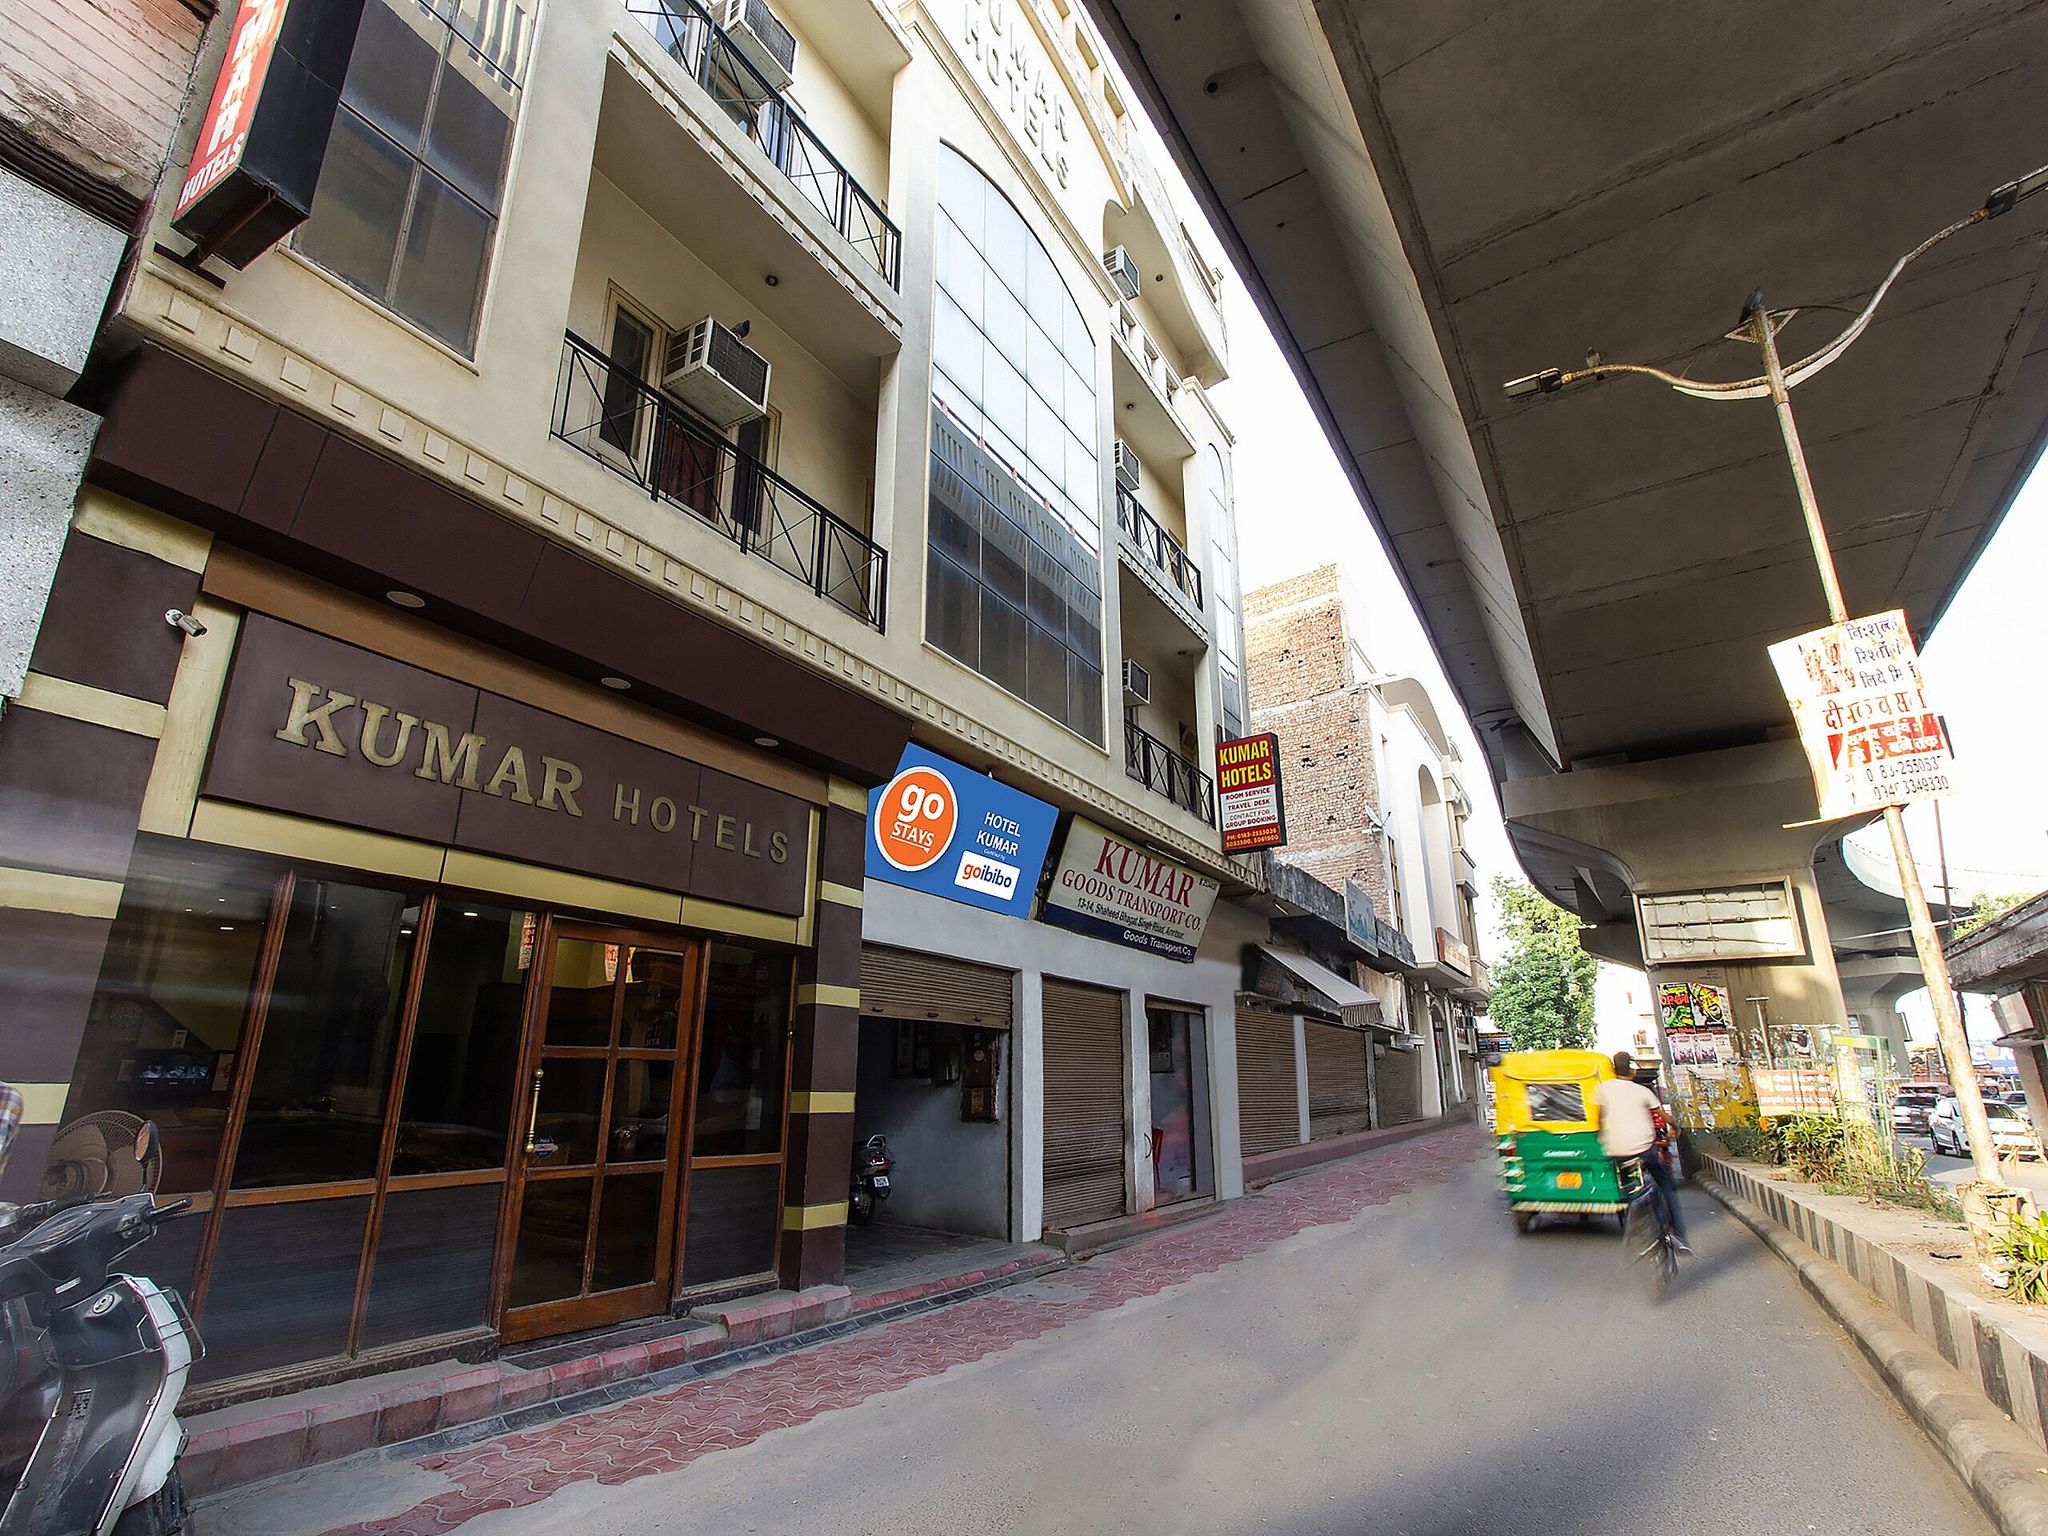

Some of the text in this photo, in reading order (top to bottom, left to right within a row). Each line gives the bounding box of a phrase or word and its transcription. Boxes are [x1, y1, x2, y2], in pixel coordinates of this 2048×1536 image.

[177, 132, 245, 211] HOTELS
[1220, 740, 1269, 766] KUMAR
[275, 677, 789, 864] KUMAR HOTELS
[1221, 762, 1272, 788] HOTELS
[897, 784, 945, 823] go
[1225, 787, 1271, 800] ROOM SERVICE
[1228, 798, 1270, 811] TRAVEL DESK
[984, 811, 1021, 837] HOTEL
[1225, 814, 1276, 828] GROUP BOOKING
[1230, 811, 1256, 821] CONTACT
[891, 821, 935, 847] STAYS
[976, 830, 1019, 856] KUMAR
[962, 862, 1012, 888] goibibo
[1093, 837, 1195, 908] KUMAR
[1062, 869, 1202, 931] GOODS TRANSPORT CO.
[1095, 904, 1120, 920] Shaheed
[1123, 929, 1148, 945] Goods
[1149, 937, 1182, 954] Transport
